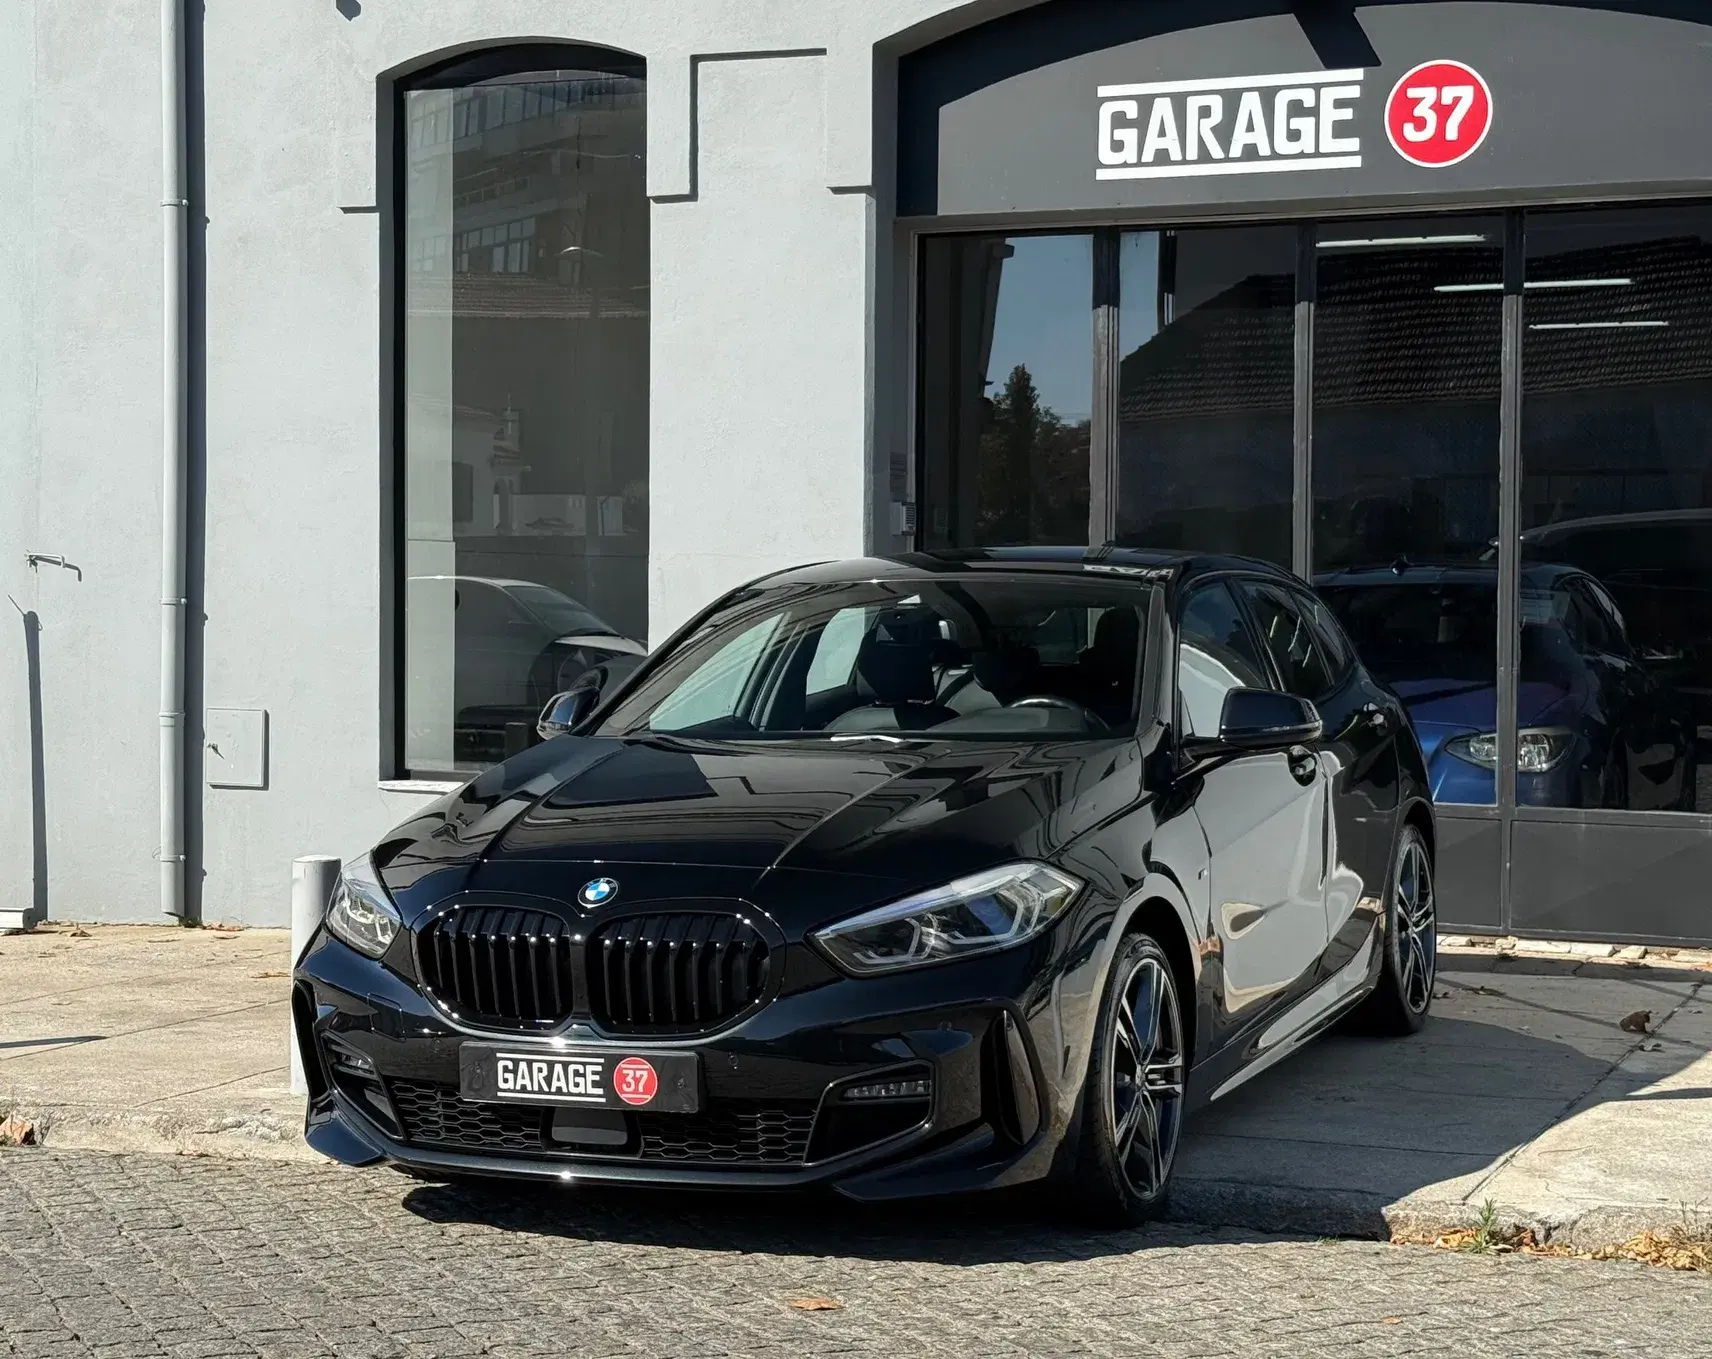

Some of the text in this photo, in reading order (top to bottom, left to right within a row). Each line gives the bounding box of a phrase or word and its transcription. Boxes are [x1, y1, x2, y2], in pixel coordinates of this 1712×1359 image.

[1098, 85, 1474, 165] GARAGE 37
[497, 1060, 648, 1095] GARAGE 37
